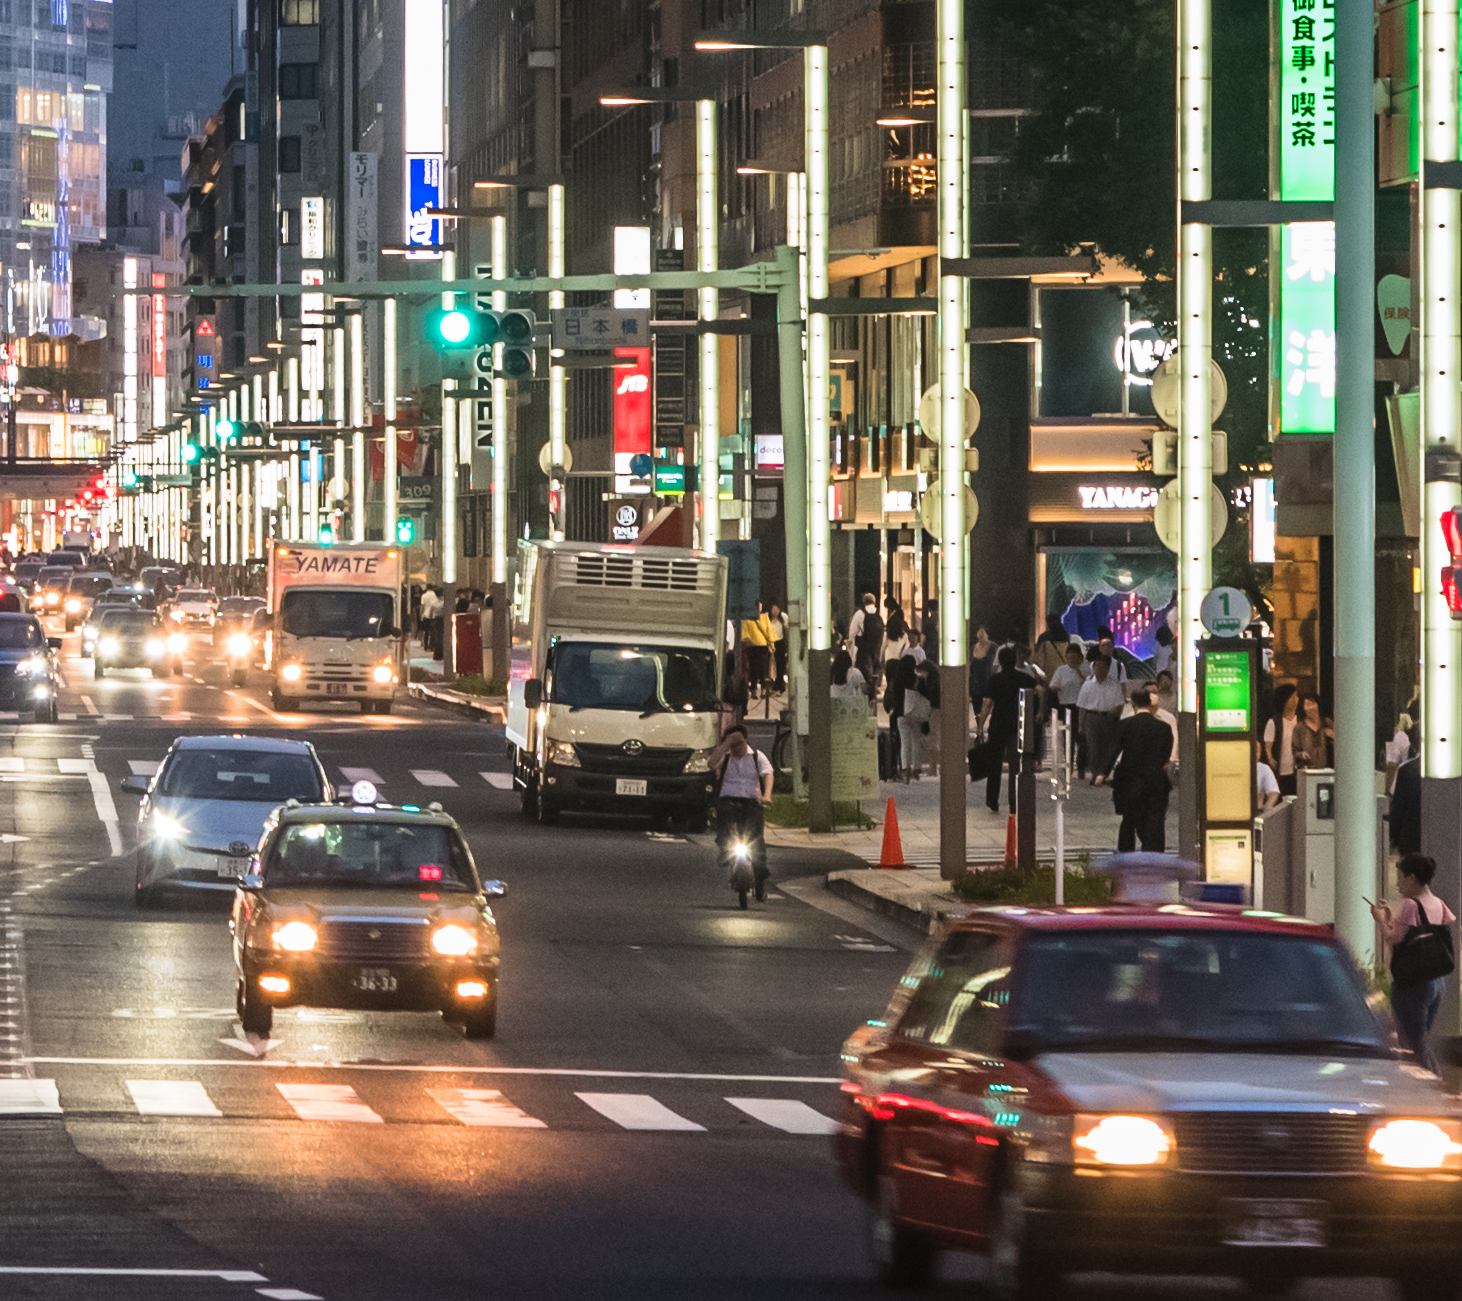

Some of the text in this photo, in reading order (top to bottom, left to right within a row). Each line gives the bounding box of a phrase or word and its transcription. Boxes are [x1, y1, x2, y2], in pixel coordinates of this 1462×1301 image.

[565, 318, 638, 335] 日本橋
[617, 374, 648, 395] JTB
[759, 445, 782, 454] doco
[404, 481, 432, 498] 309
[294, 555, 379, 576] YAMATE
[1218, 593, 1230, 618] 1
